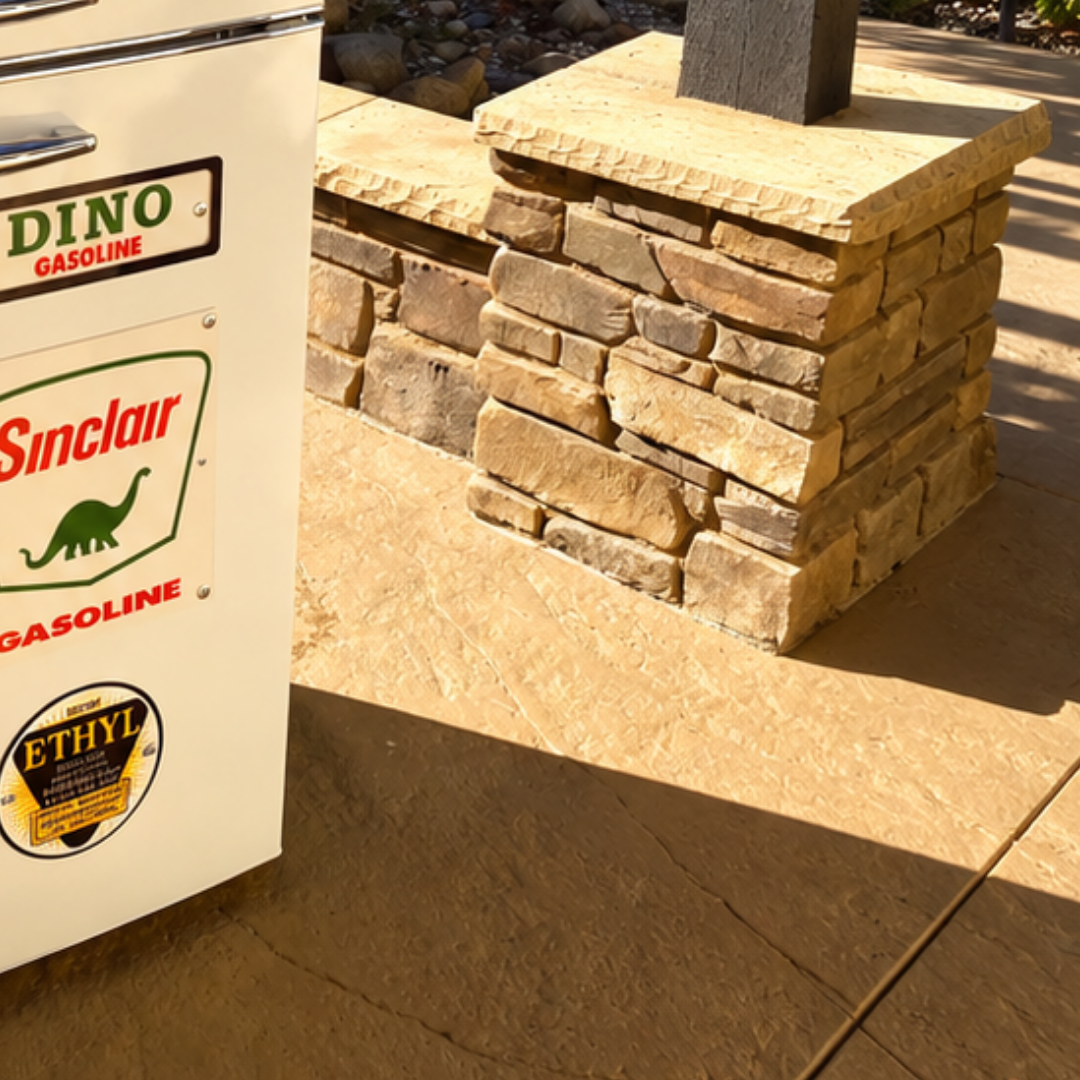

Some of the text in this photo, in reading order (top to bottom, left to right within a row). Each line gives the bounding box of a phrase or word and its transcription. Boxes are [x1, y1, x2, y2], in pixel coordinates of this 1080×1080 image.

[7, 184, 173, 257] DINO
[34, 235, 143, 278] GASOLINE
[23, 707, 141, 772] ETHYL
